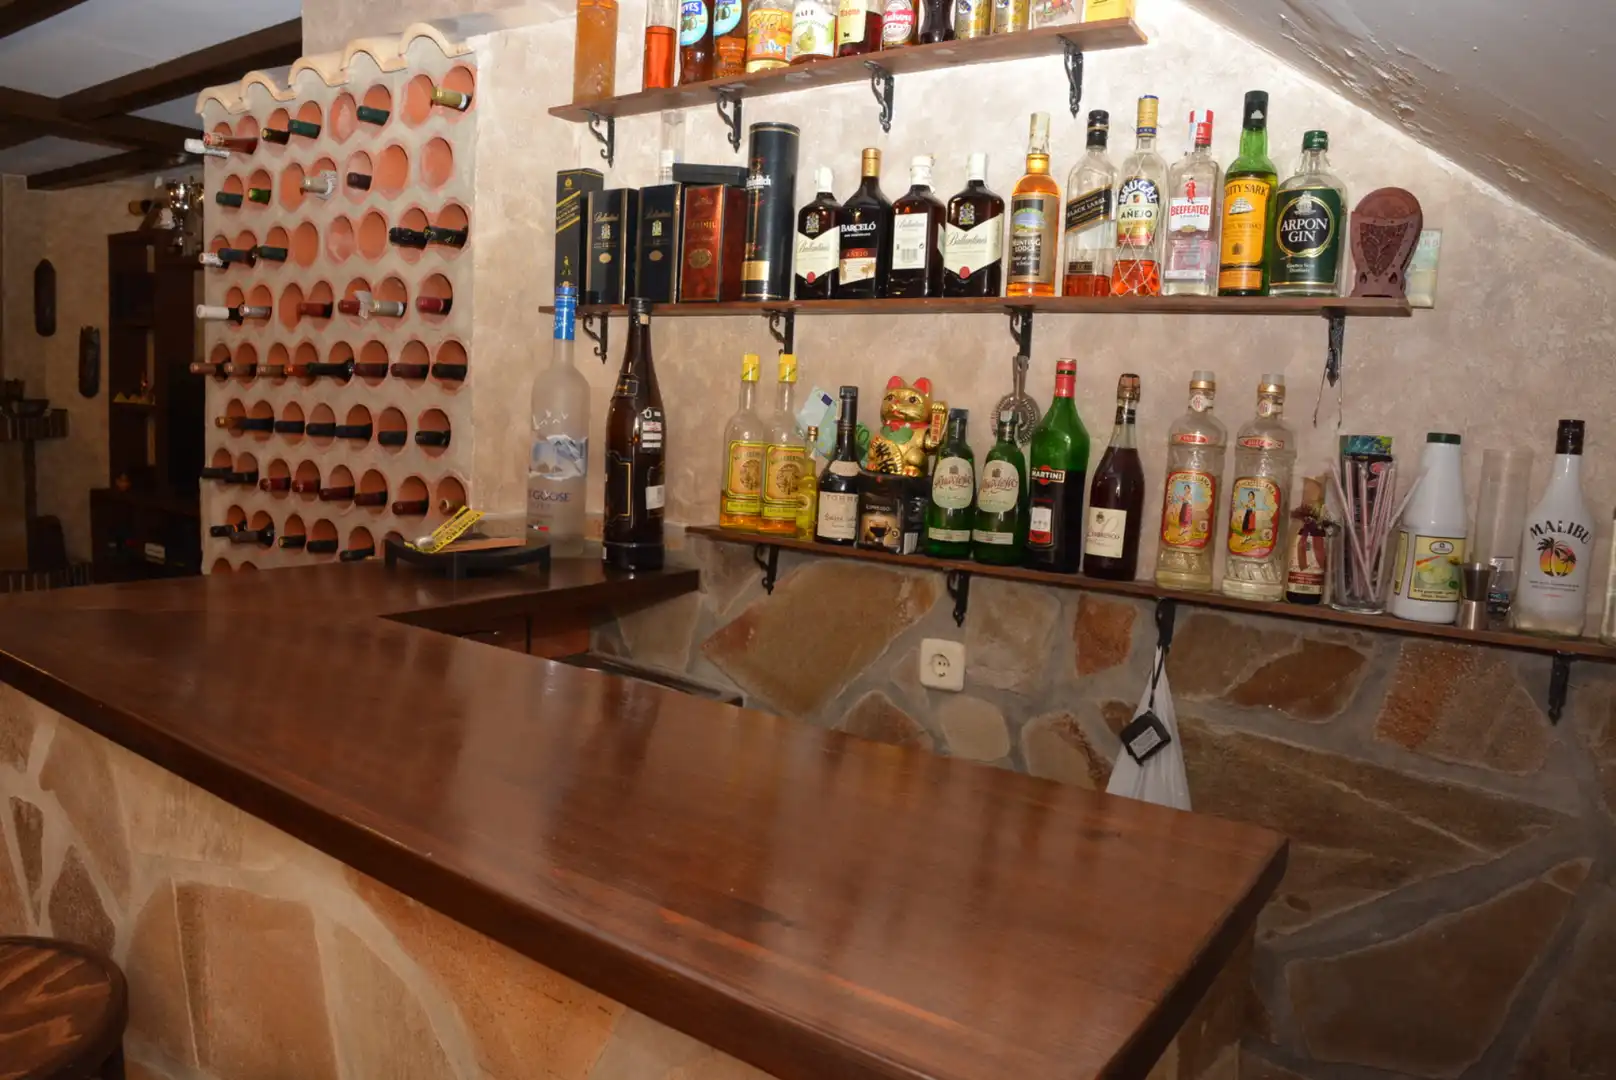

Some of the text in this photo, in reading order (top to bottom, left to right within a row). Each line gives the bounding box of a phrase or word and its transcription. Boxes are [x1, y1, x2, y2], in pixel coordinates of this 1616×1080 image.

[1120, 208, 1153, 220] AÑEJO
[1170, 204, 1210, 216] BEEFEATER
[840, 221, 877, 233] BARCELÓ
[1281, 217, 1329, 232] ARPON
[1287, 230, 1317, 243] GIN
[1031, 470, 1062, 480] MARTINI
[1530, 520, 1593, 545] MALIBU
